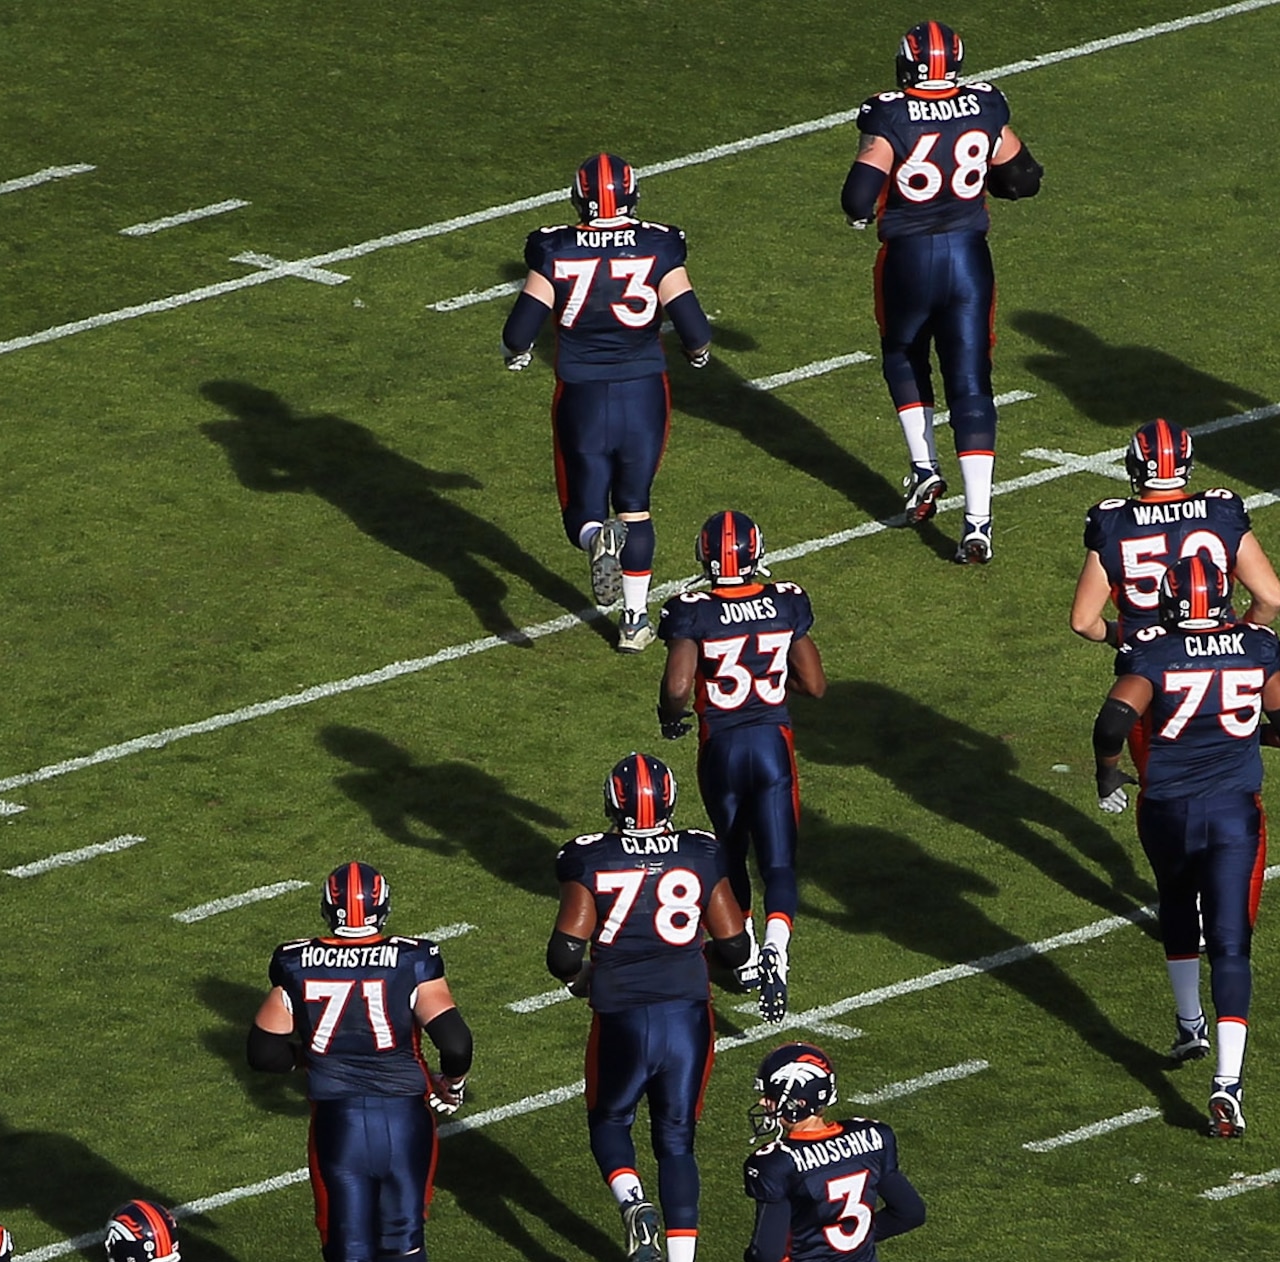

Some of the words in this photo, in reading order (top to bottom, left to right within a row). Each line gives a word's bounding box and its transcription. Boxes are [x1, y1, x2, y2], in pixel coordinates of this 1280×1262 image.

[907, 93, 981, 121] BEADLES
[894, 129, 992, 204] 68
[576, 225, 636, 248] KUPER
[552, 254, 659, 329] 73
[1132, 499, 1207, 526] WALTON
[720, 596, 777, 625] JONES
[1184, 632, 1245, 657] CLARK
[701, 628, 796, 711] 33
[1158, 667, 1266, 741] 75
[620, 829, 680, 855] CLADY
[594, 861, 703, 946] 78
[300, 943, 398, 969] HOCHSTEIN
[302, 979, 397, 1056] 71
[792, 1128, 884, 1176] HAUSCHKA
[823, 1169, 874, 1254] 3
